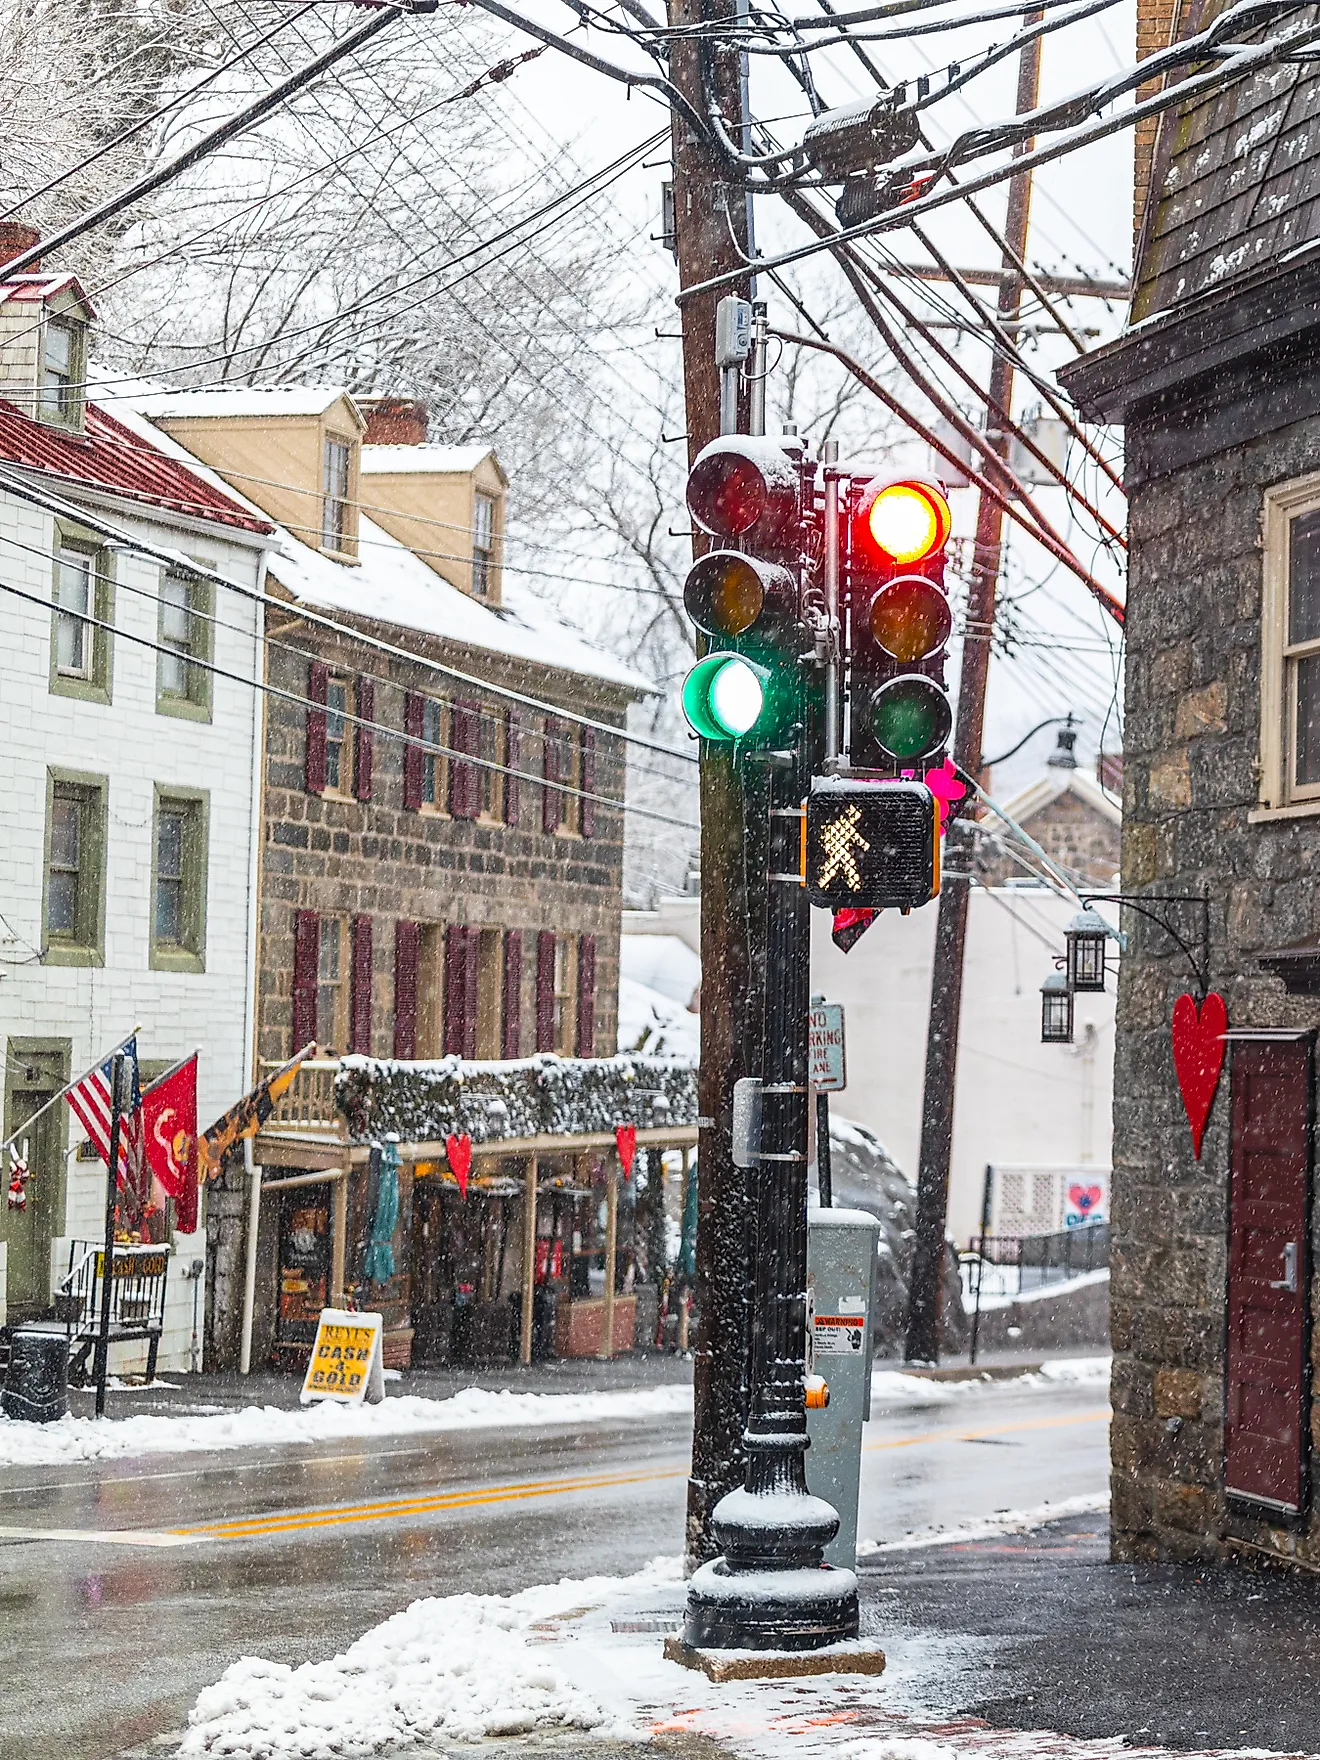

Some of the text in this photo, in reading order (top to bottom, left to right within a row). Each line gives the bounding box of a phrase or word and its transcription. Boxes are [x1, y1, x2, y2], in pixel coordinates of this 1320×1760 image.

[809, 1011, 827, 1028] NO
[809, 1029, 841, 1046] RKING
[810, 1048, 828, 1059] IRE
[813, 1062, 831, 1073] ANE
[825, 1317, 858, 1327] WARNING
[318, 1345, 370, 1361] CASH
[313, 1370, 361, 1386] GOLD
